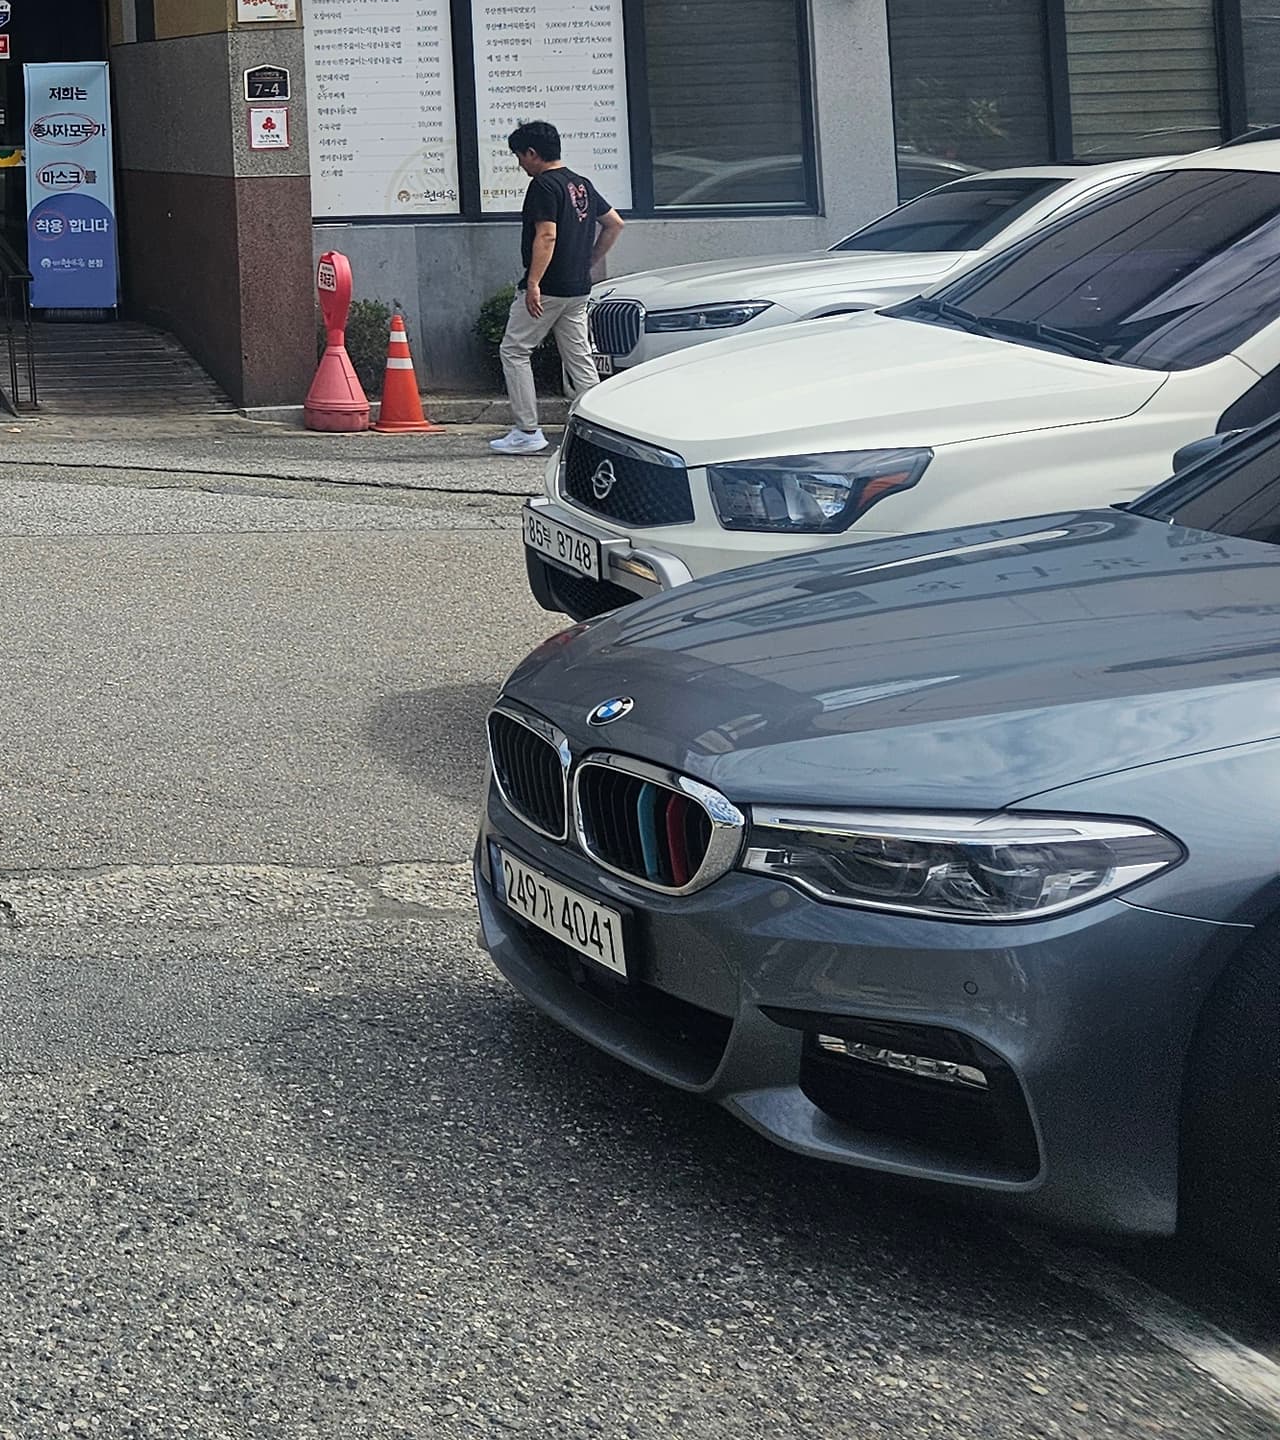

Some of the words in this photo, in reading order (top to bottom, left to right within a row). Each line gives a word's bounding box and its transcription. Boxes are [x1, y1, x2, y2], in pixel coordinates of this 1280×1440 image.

[48, 86, 89, 101] 저희는
[253, 82, 281, 97] 7-4
[41, 170, 82, 185] 마스크
[35, 218, 64, 234] 착용
[68, 217, 109, 233] 합니다
[592, 355, 610, 372] 276
[528, 516, 552, 551] 85부
[556, 530, 592, 570] 8748
[504, 859, 556, 929] 249가
[561, 895, 617, 964] 4041
